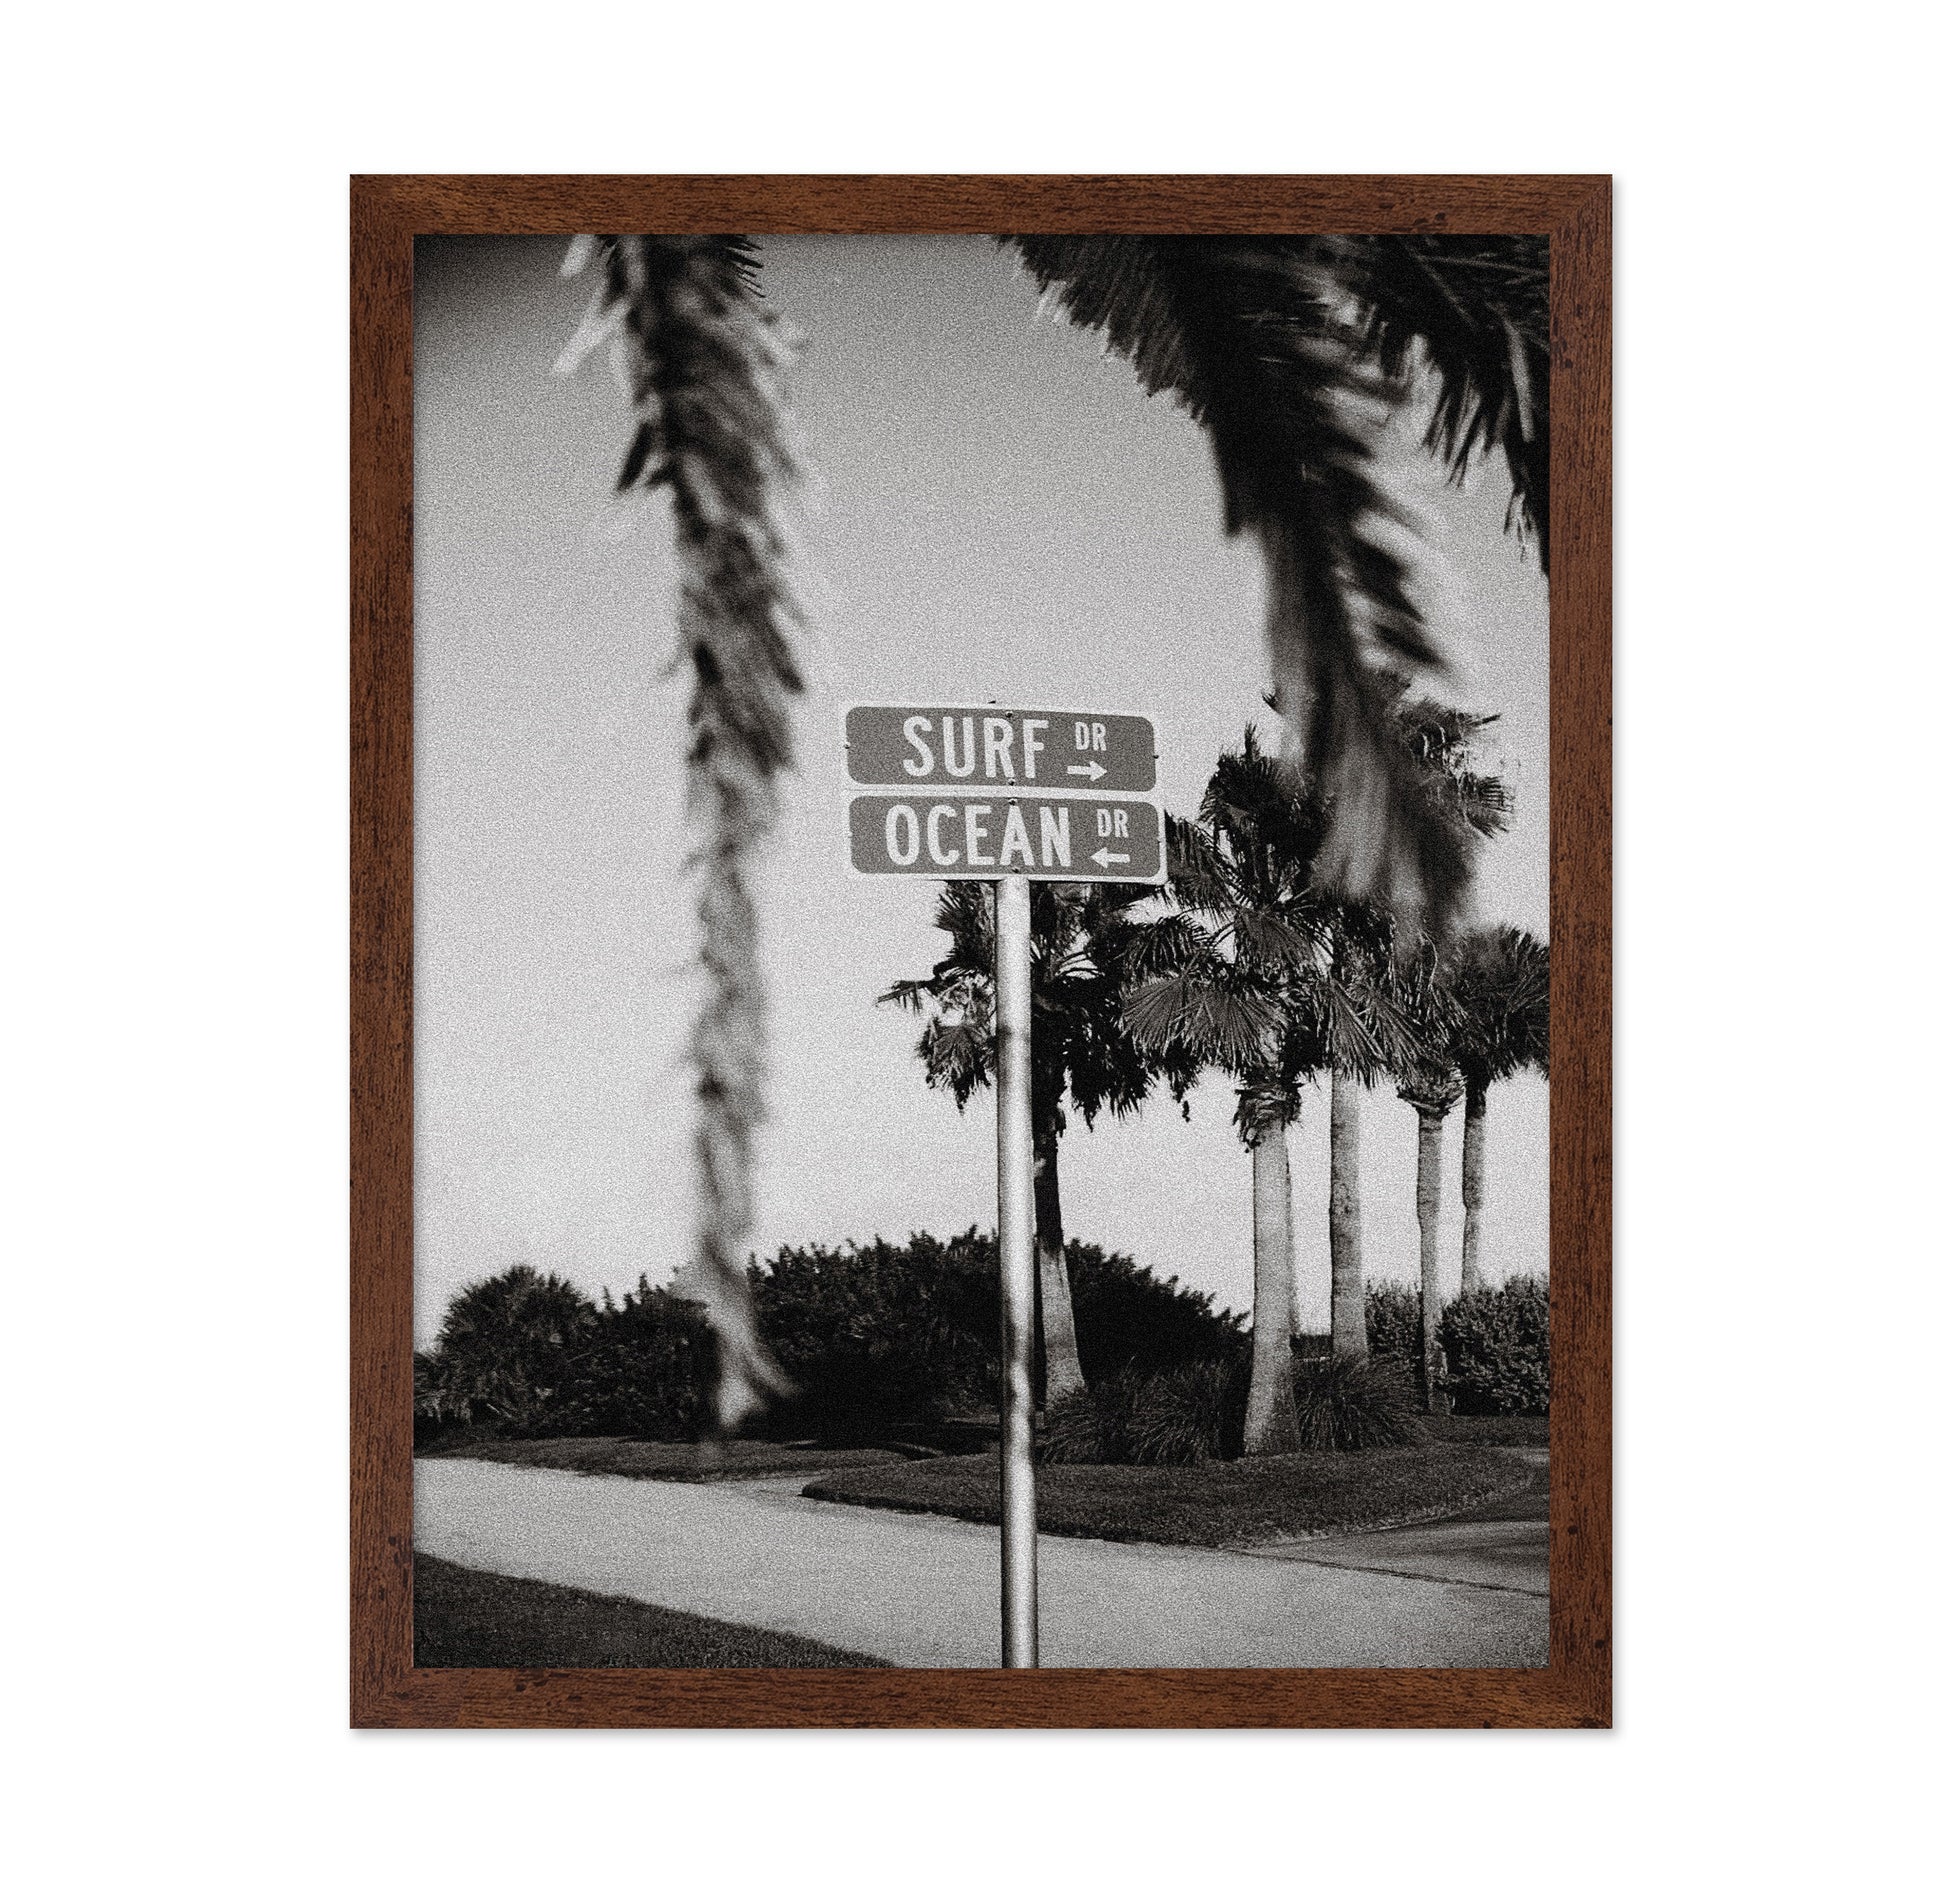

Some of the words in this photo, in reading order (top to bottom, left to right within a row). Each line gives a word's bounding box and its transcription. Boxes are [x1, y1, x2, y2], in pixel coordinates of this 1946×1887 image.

[903, 716, 1049, 779] SURF
[1075, 722, 1107, 751] DR
[885, 804, 1071, 867] OCEAN
[1097, 809, 1129, 838] DR
